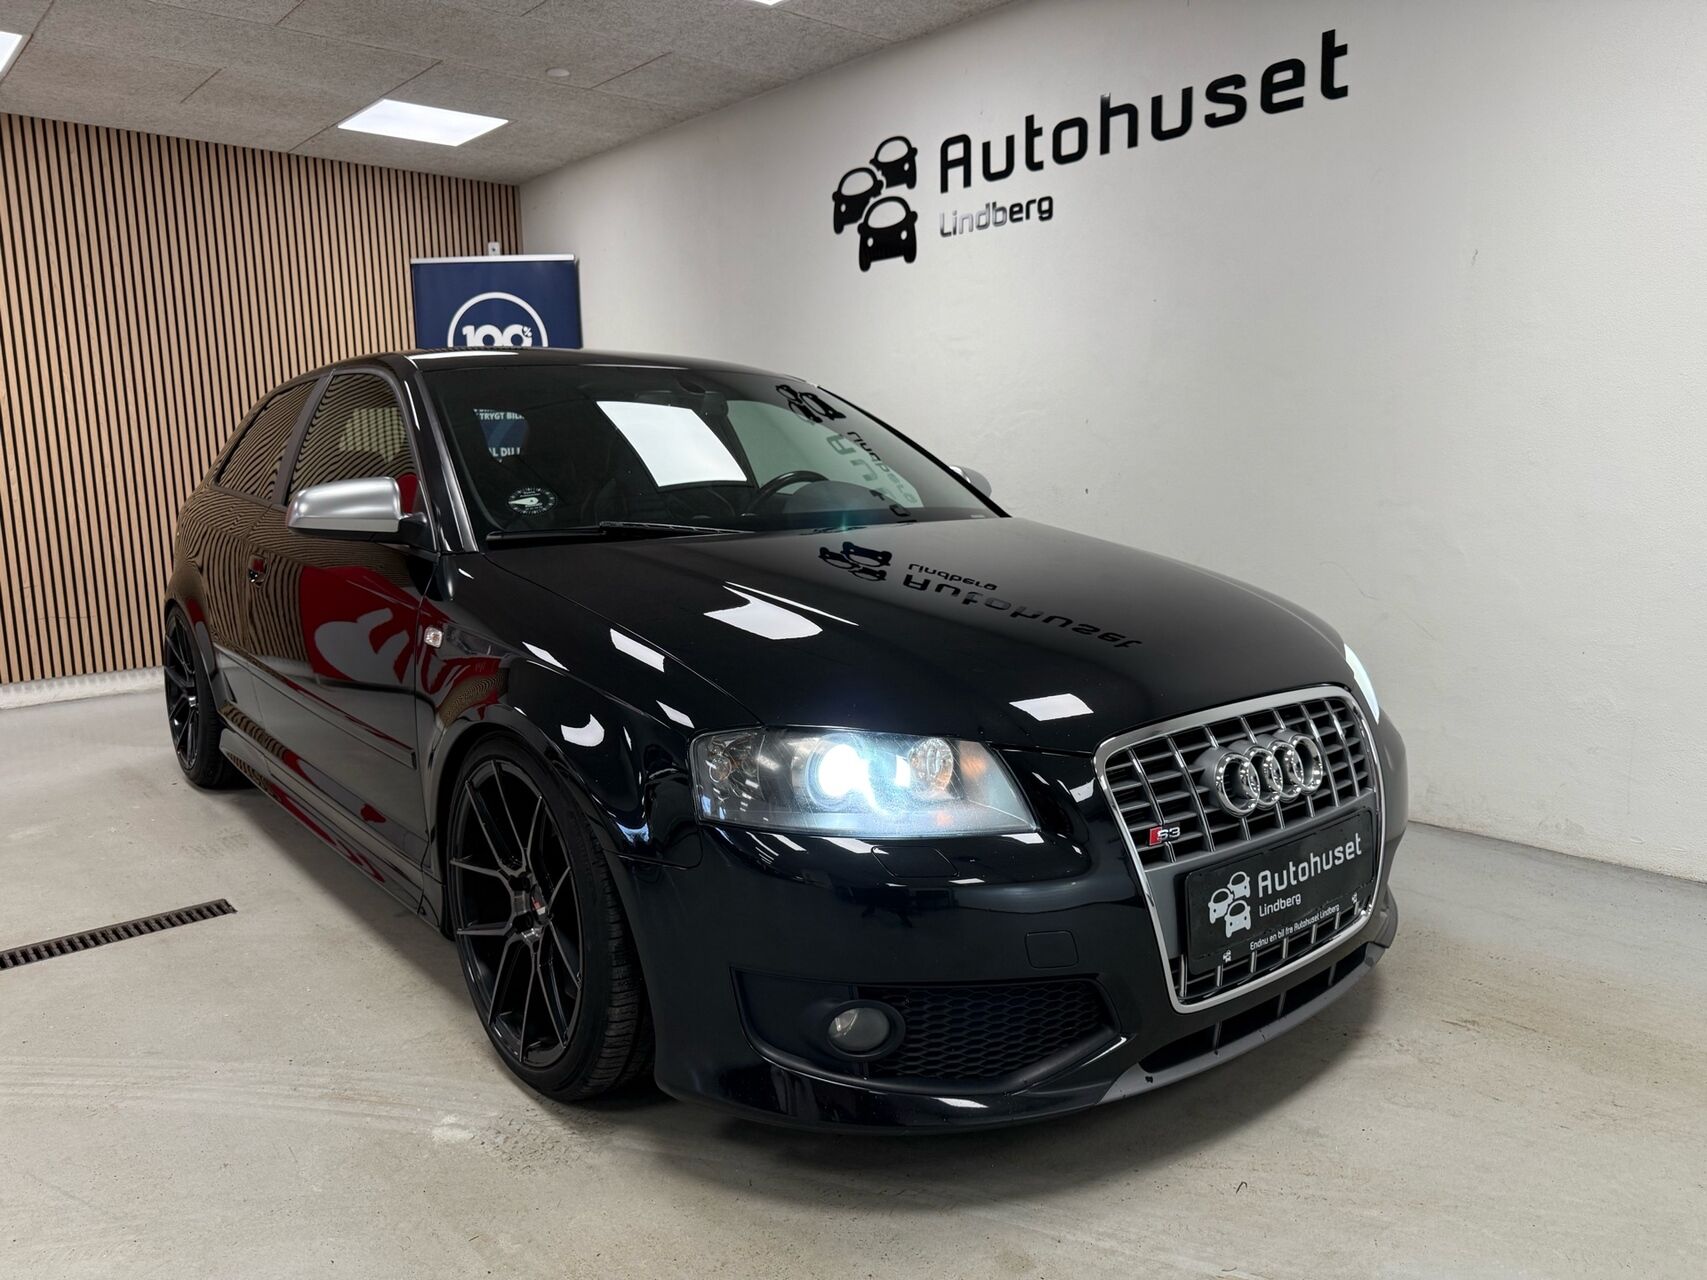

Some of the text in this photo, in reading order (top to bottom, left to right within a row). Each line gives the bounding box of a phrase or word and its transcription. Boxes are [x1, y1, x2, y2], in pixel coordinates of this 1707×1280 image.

[940, 29, 1348, 193] Autohuset
[940, 195, 1054, 237] Lindberg
[480, 412, 505, 420] TRYGT
[1258, 832, 1362, 898] Autohuset
[1259, 893, 1302, 917] Lindberg
[1270, 934, 1277, 942] en
[1277, 928, 1285, 939] bil
[1294, 914, 1320, 931] Autohuset
[1319, 904, 1339, 919] Lindberg
